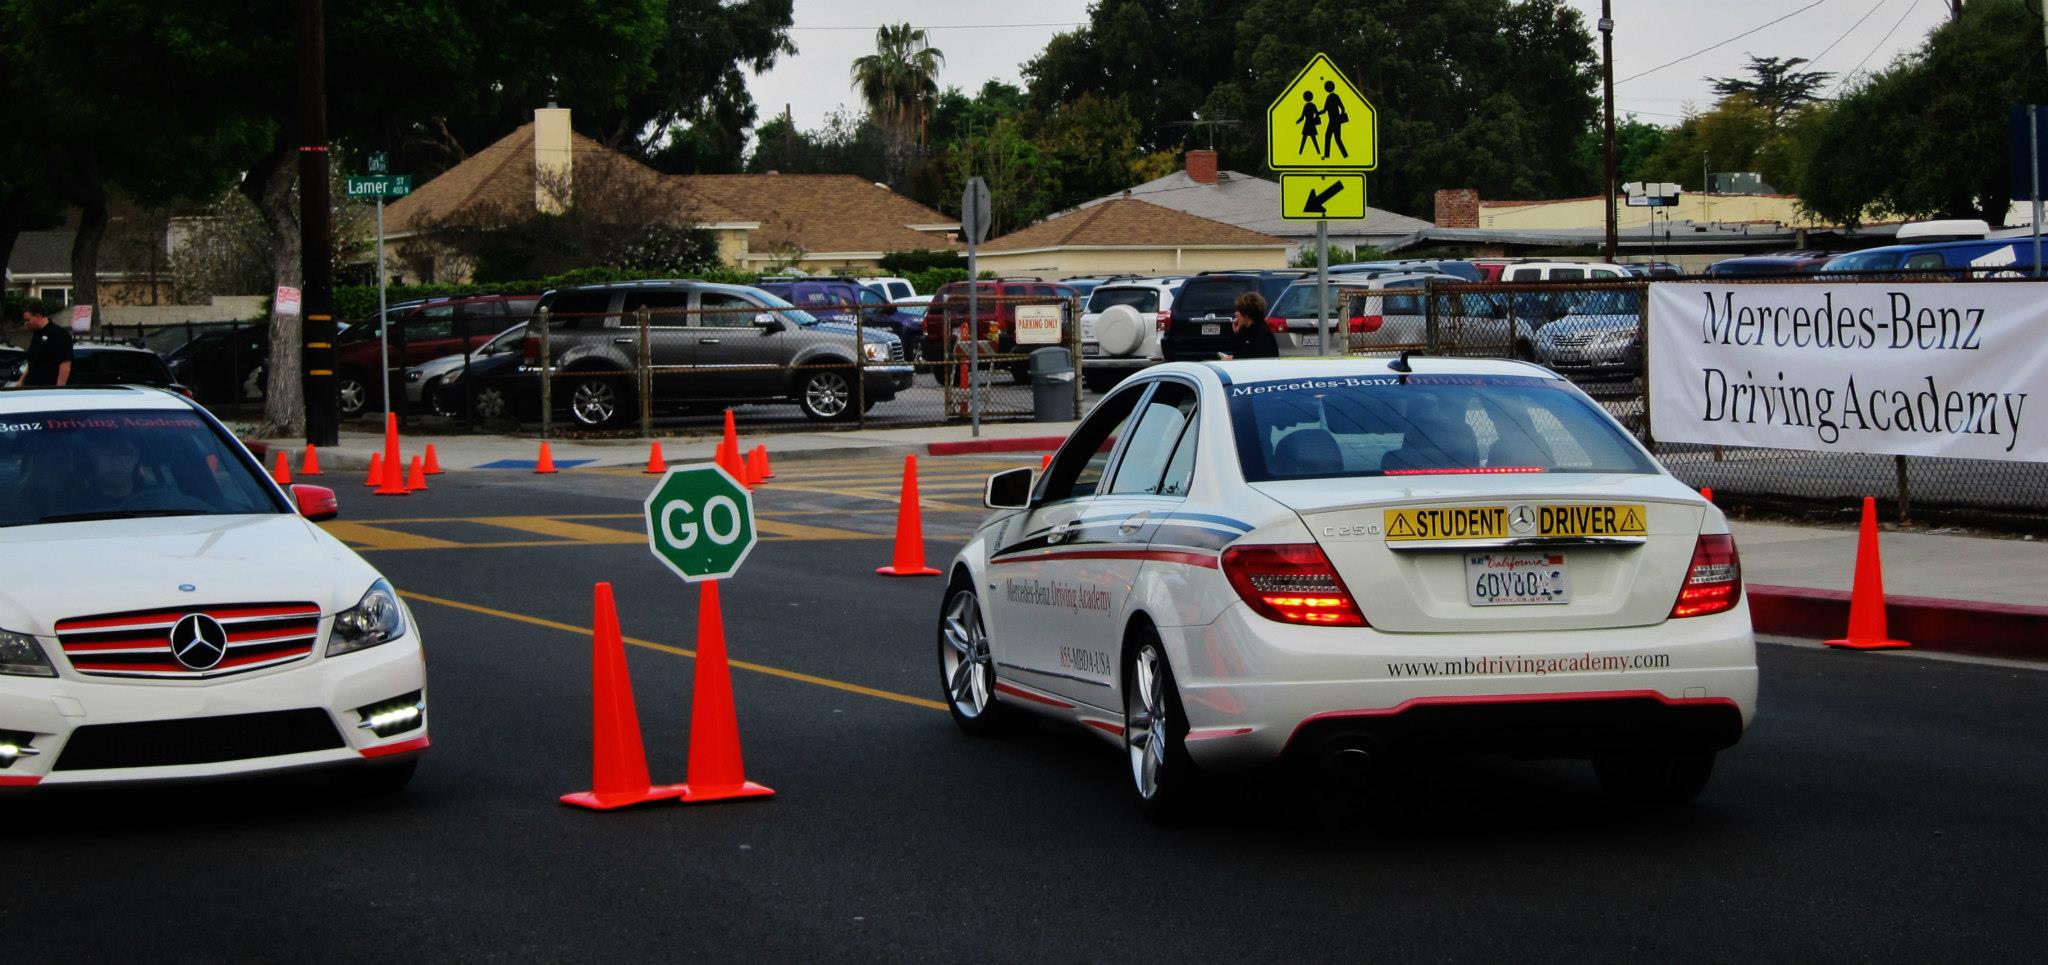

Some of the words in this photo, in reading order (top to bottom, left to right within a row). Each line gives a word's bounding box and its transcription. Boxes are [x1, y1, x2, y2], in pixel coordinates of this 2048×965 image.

[348, 179, 388, 194] Lamer
[1018, 319, 1043, 330] PARKING
[1044, 318, 1059, 329] ONLY
[1702, 291, 1986, 350] Mercedes-Benz
[1231, 377, 1400, 397] Mercedes-Benz
[48, 418, 119, 431] Driving
[123, 417, 200, 429] Academy
[661, 495, 741, 550] GO
[1322, 526, 1335, 537] C
[1338, 525, 1380, 537] 250
[1416, 508, 1505, 538] STUDENT
[1539, 507, 1617, 535] DRIVER
[1487, 553, 1548, 571] California
[1006, 578, 1051, 606] Mercedes-Benz
[1051, 580, 1078, 615] Driving
[1079, 584, 1112, 618] Academy
[1387, 652, 1671, 677] www.mbdrivingacademy.com
